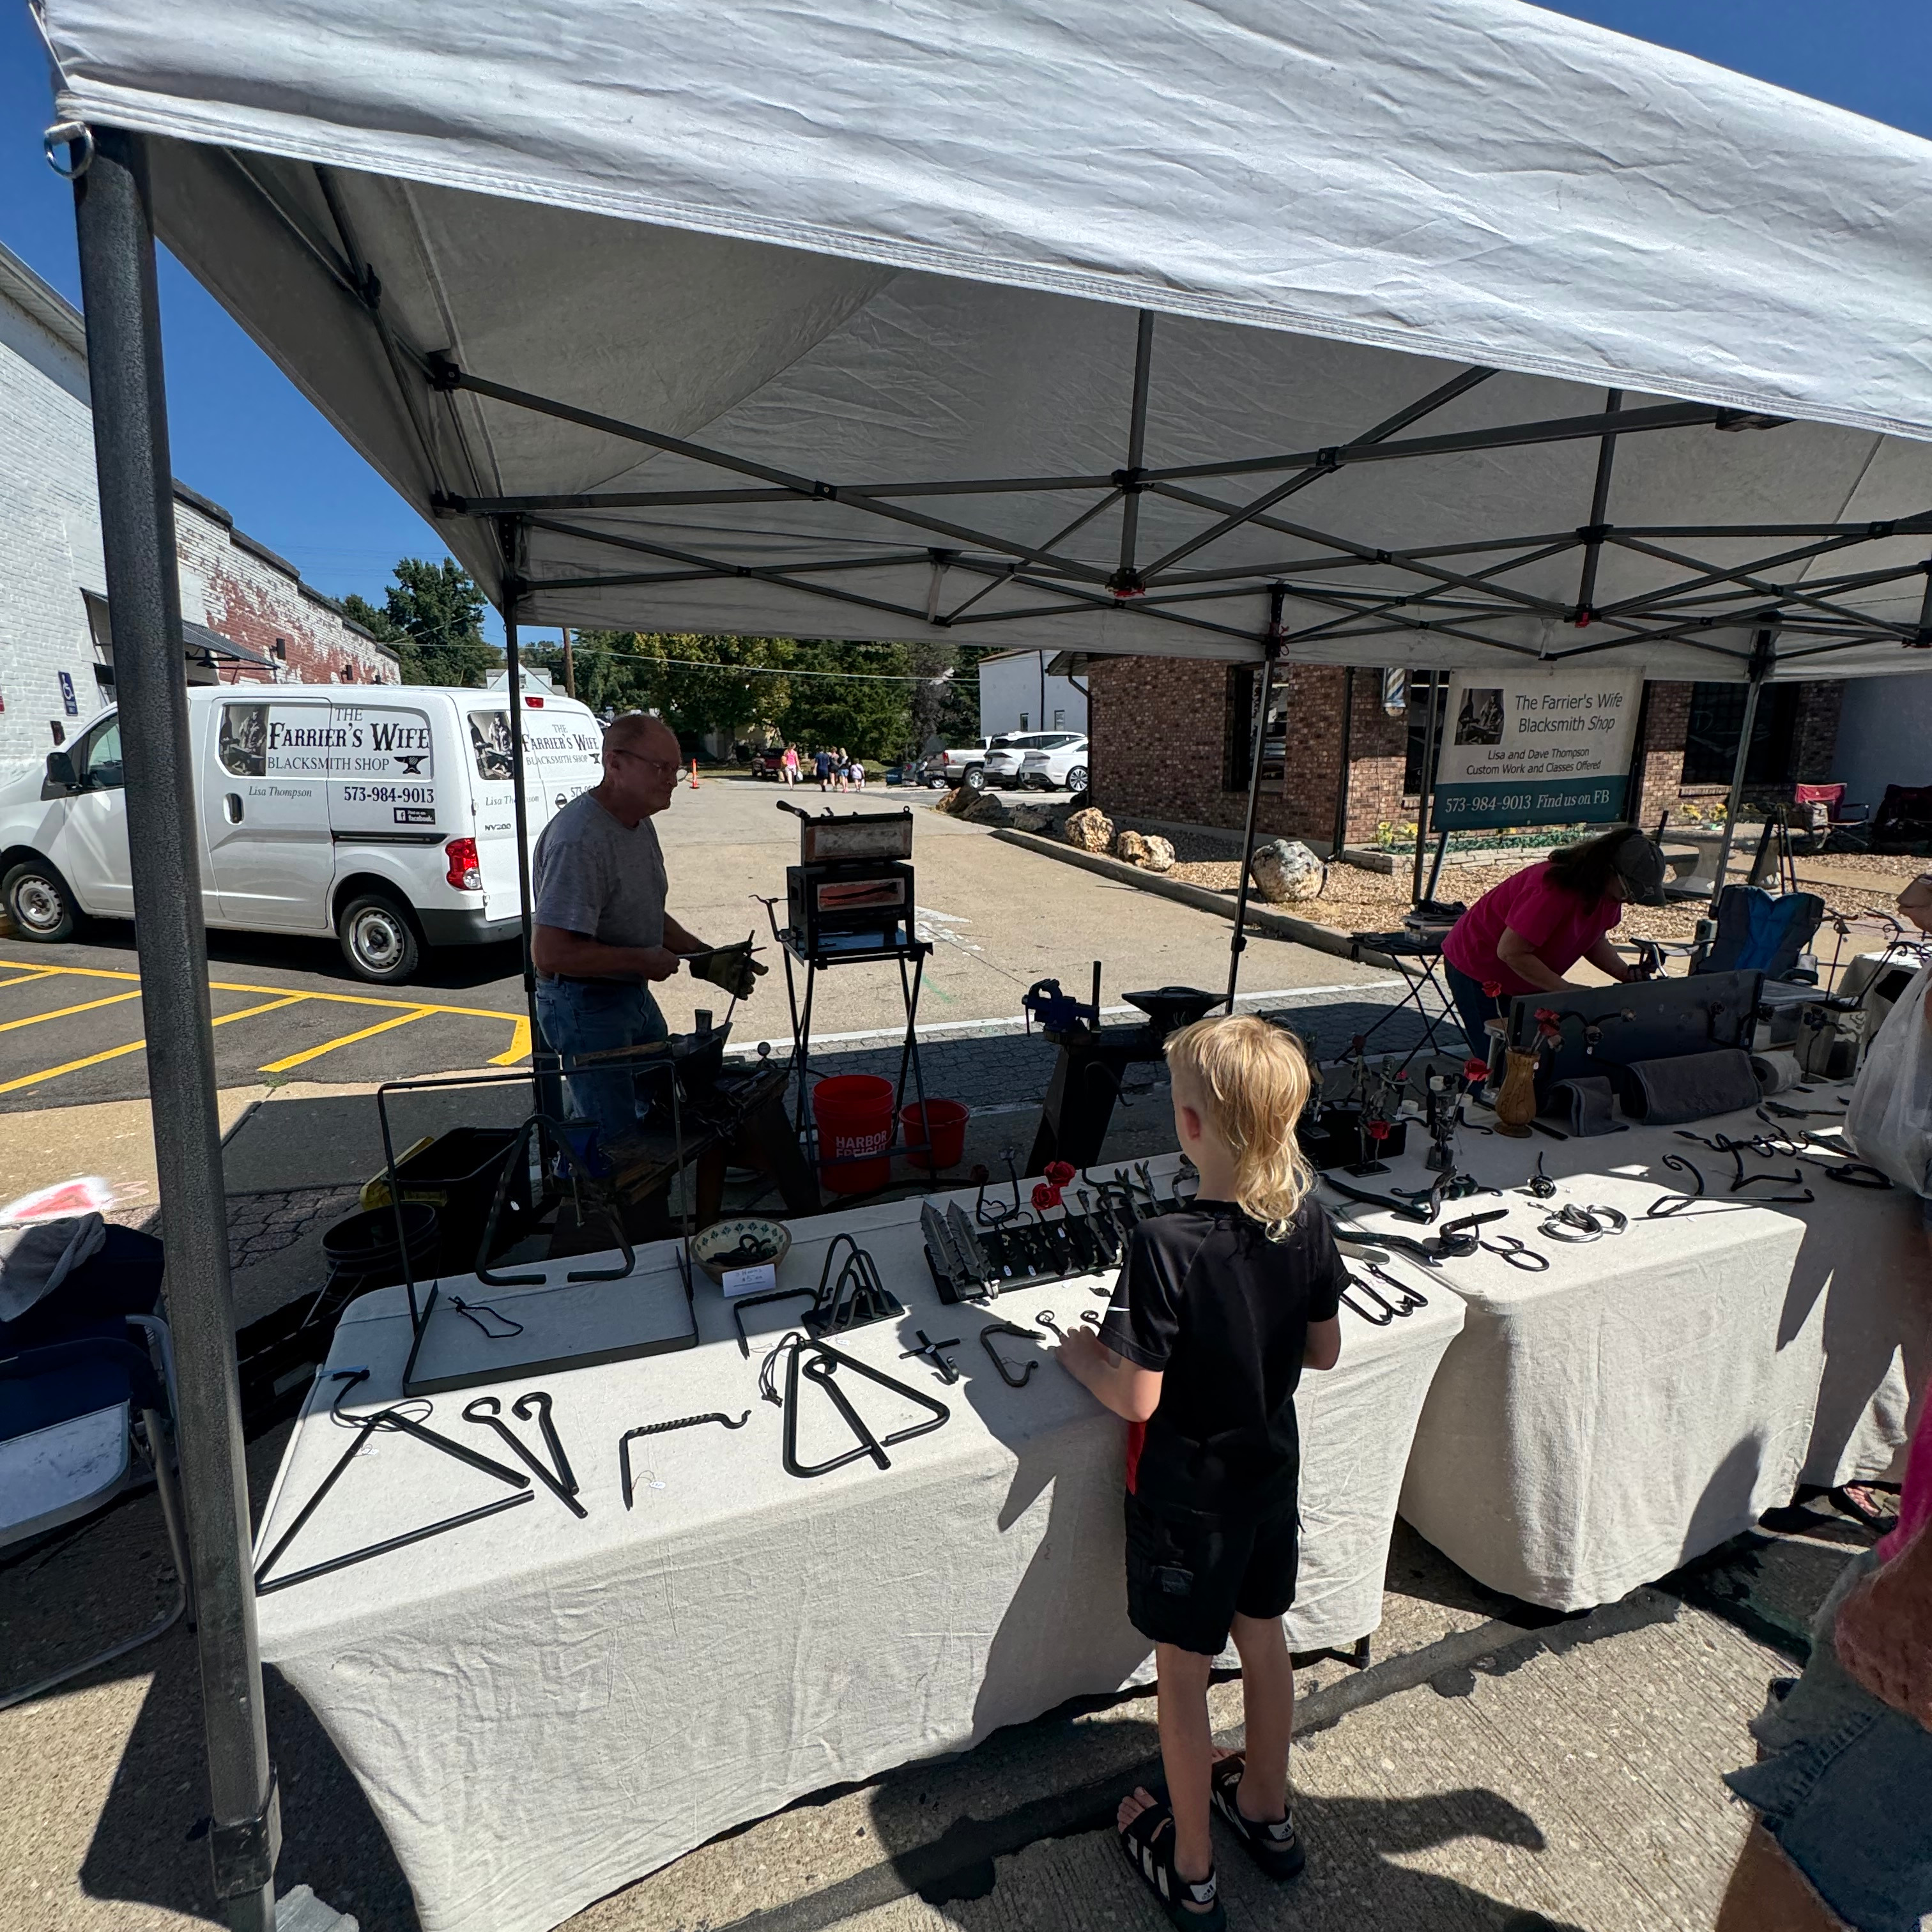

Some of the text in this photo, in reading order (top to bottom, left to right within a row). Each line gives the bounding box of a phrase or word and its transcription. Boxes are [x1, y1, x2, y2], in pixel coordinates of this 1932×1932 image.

[1515, 692, 1623, 710] The Farrier's Wife
[334, 708, 363, 721] THE
[552, 724, 568, 733] THE
[1519, 716, 1615, 733] Blacksmith Shop
[268, 722, 431, 751] FARRIER'S WIFE
[521, 733, 599, 752] FARRIER'S WIFE
[526, 755, 588, 765] BLACKSMITH SHOP
[1488, 748, 1590, 760] Lisa and Dave Thompson
[268, 756, 389, 771] BLACKSMITH SHOP
[1466, 760, 1602, 775] Custom Work and Classes Offered
[249, 786, 312, 799] Lisa Thompson
[344, 786, 434, 804] 573-984-9013
[486, 795, 539, 806] Lisa Thson
[1445, 790, 1610, 813] 573-984-9013 Find us on FB
[836, 1130, 887, 1148] HARBOR
